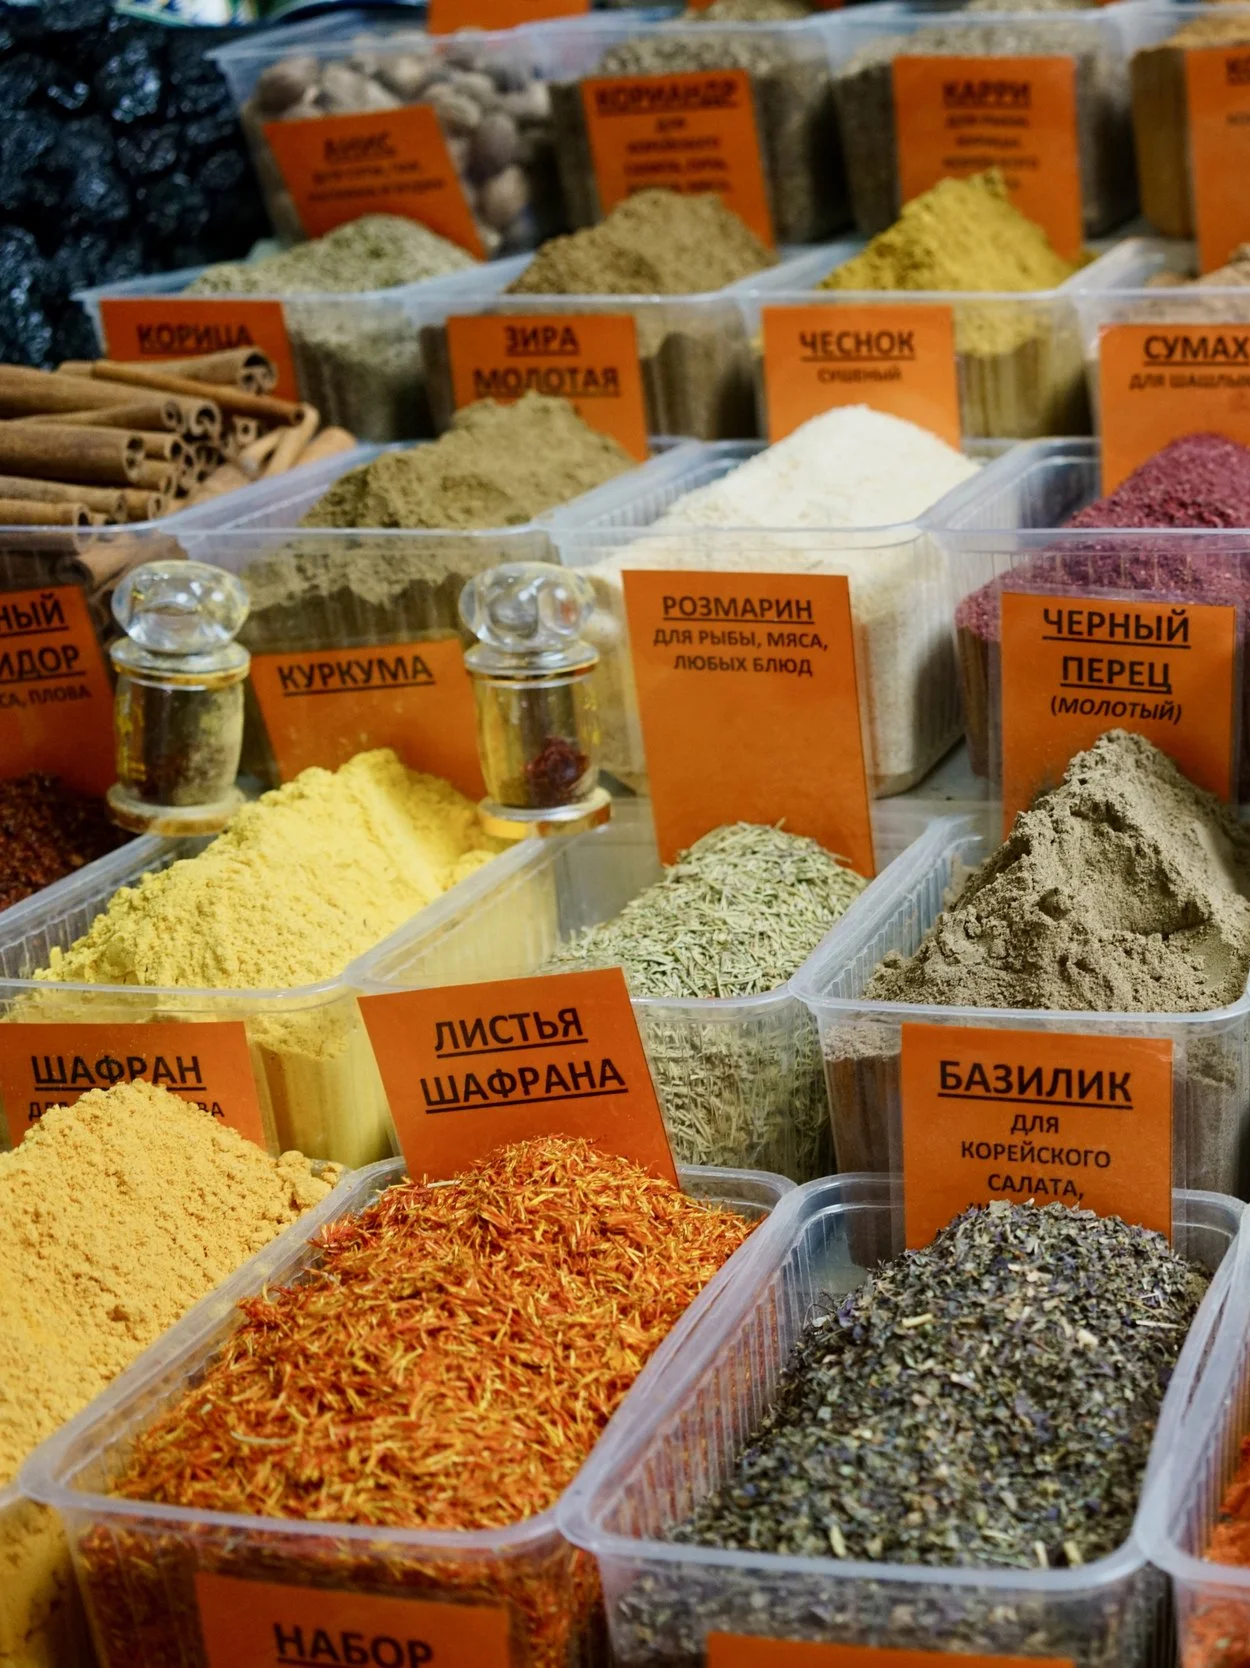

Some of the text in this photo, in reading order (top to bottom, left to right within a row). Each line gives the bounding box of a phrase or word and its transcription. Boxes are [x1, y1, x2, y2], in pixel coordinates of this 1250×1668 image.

[136, 322, 255, 350] КОРИЦА
[505, 325, 580, 350] ЗИРА
[799, 331, 915, 355] ЧЕСНОК
[1144, 335, 1250, 360] СУМАХ
[473, 366, 619, 396] МОЛОТАЯ
[1129, 374, 1165, 391] ДЛЯ
[662, 596, 813, 619] РОЗМАРИН
[653, 628, 828, 651] ДЛЯ РЫБЫ, МЯСА,
[1043, 608, 1189, 643] ЧЕРНЫЙ
[278, 655, 433, 690] КУРКУМА
[674, 655, 813, 677] ЛЮБЫХ БЛЮД
[1062, 656, 1172, 692] ПЕРЕЦ
[28, 684, 93, 704] ПЛОВА
[1051, 696, 1182, 725] (МОЛОТЫЙ)
[434, 1007, 584, 1052] ЛИСТЬЯ
[31, 1055, 203, 1084] ШАФРАН
[420, 1058, 626, 1106] ШАФРАНА
[939, 1060, 1132, 1102] БАЗИЛИК
[1010, 1114, 1059, 1135] ДЛЯ
[961, 1140, 1111, 1169] КОРЕЙСКОГО
[988, 1173, 1085, 1201] САЛАТА,
[272, 1622, 434, 1668] НАБОР
